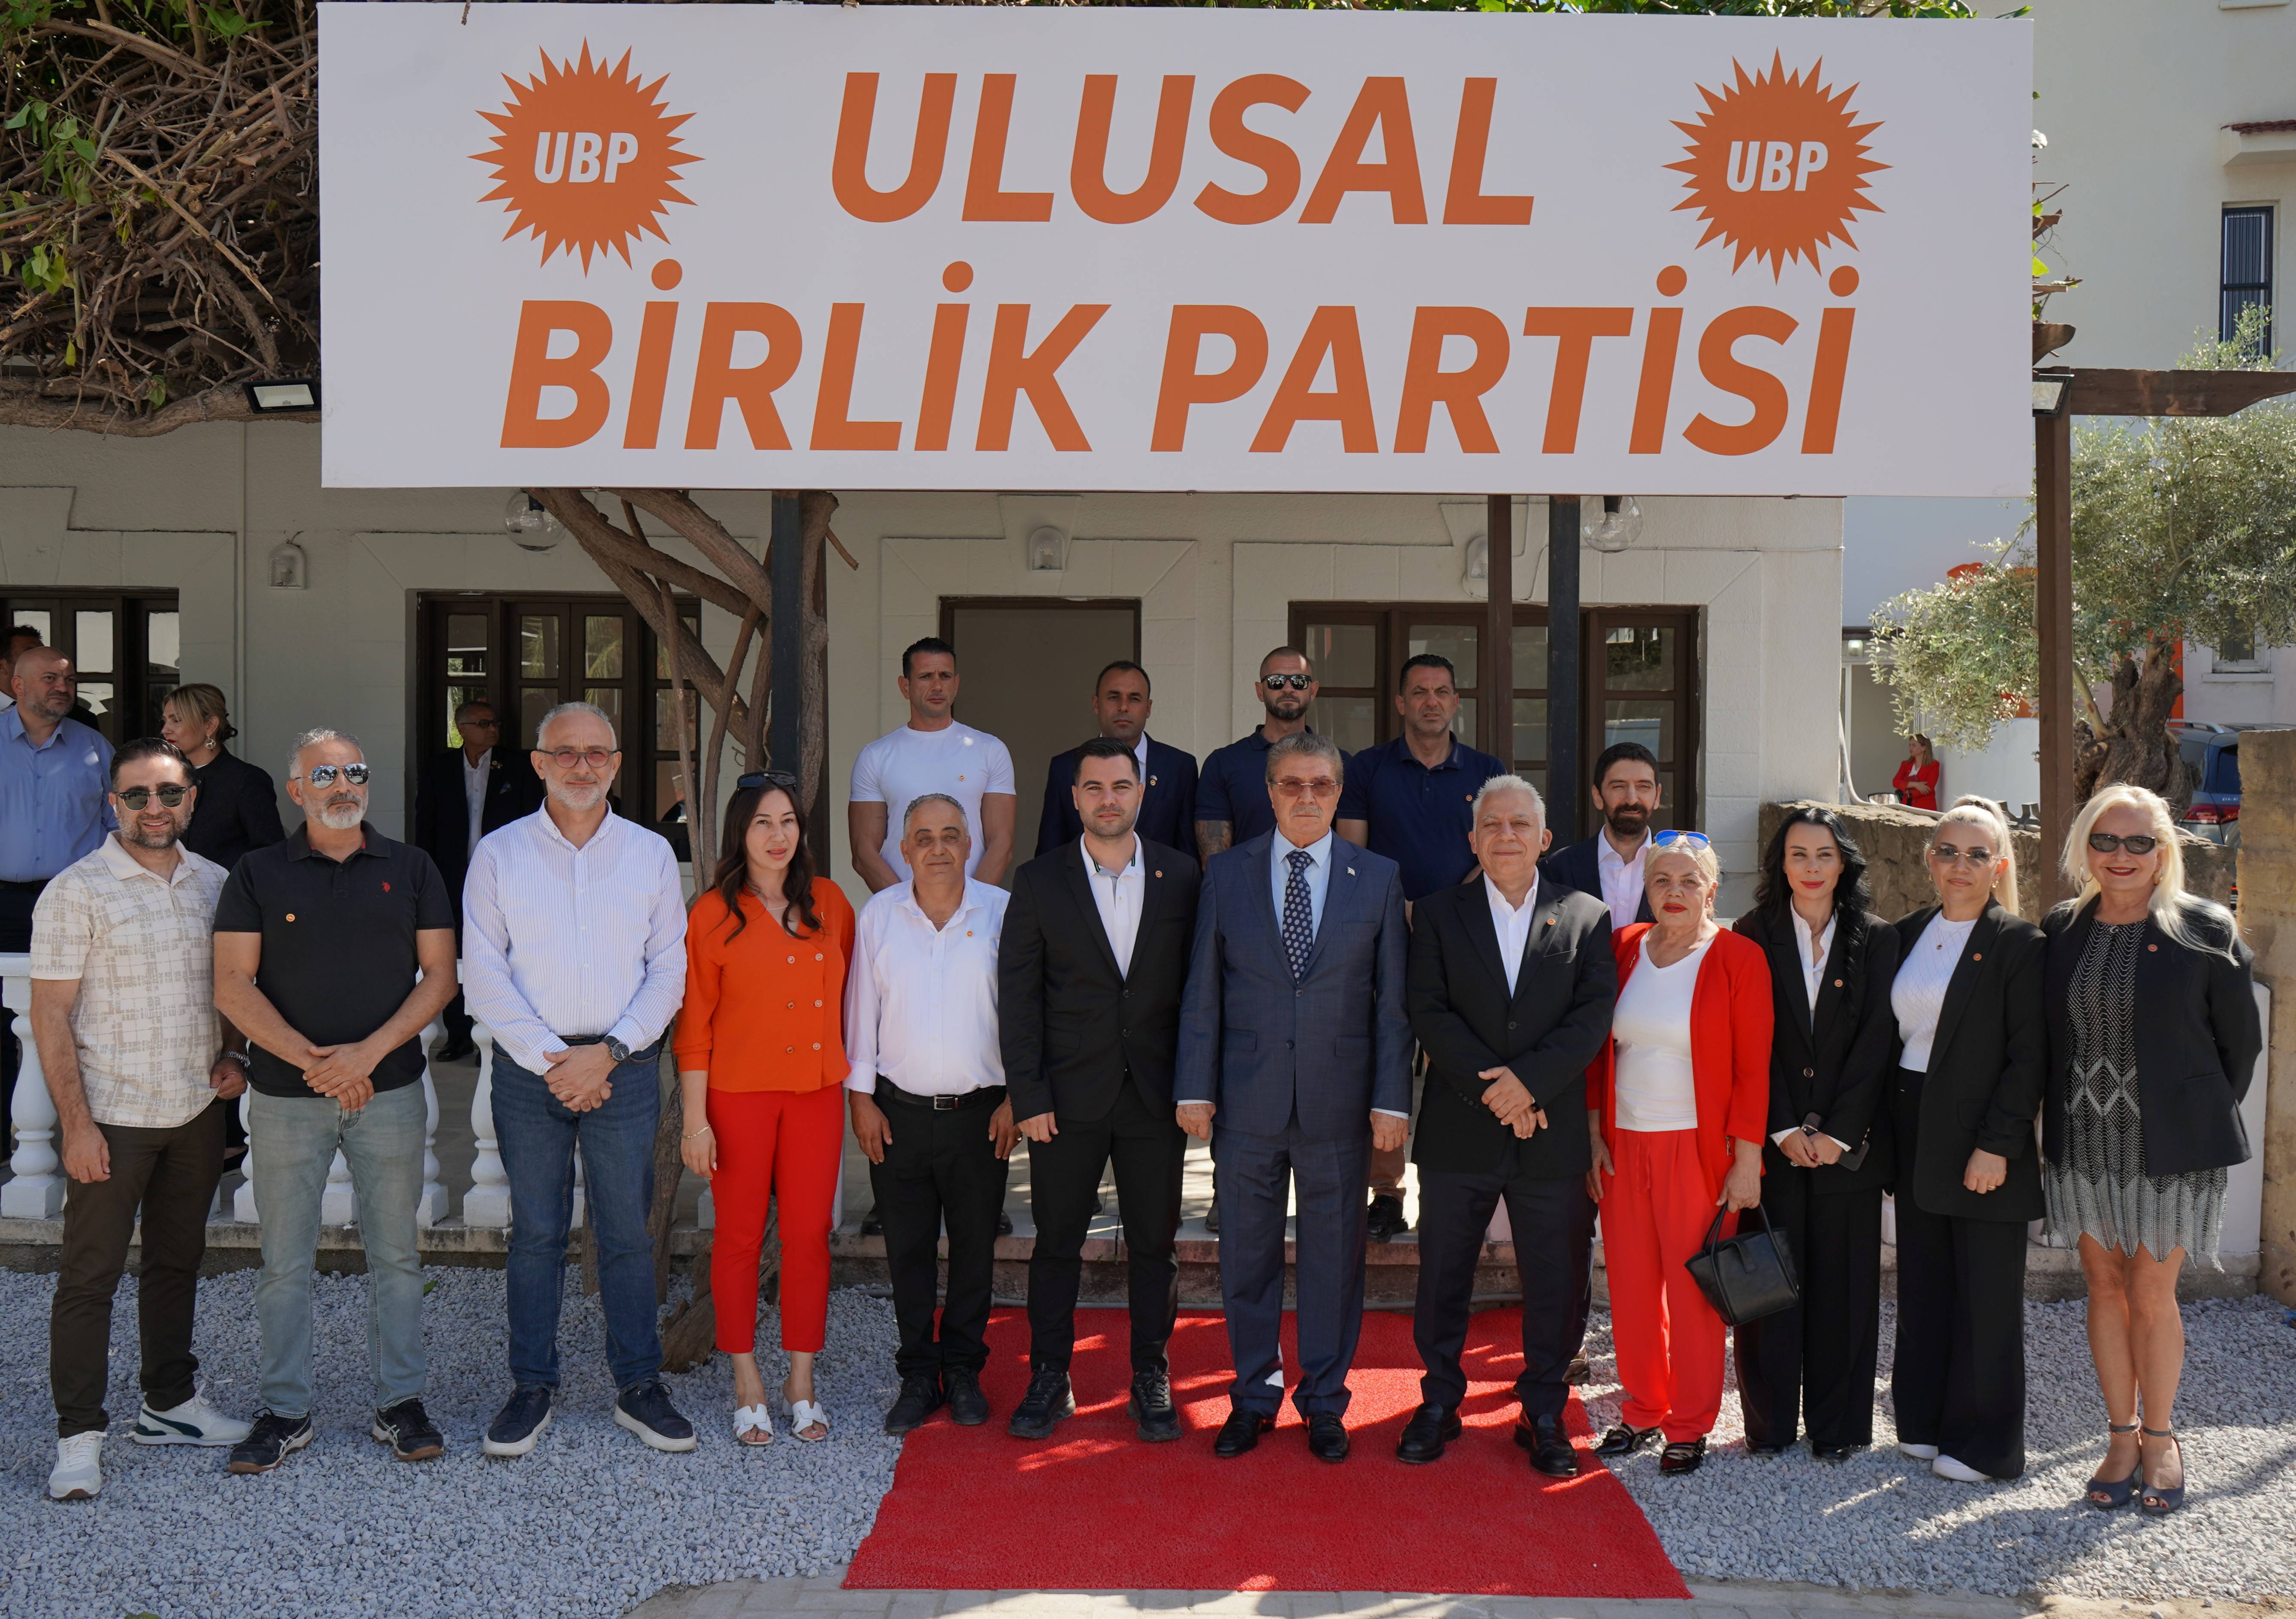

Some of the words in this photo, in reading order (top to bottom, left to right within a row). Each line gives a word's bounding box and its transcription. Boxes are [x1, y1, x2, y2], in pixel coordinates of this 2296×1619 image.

[534, 132, 638, 184] UBP
[832, 72, 1534, 225] ULUSAL
[1726, 141, 1828, 193] UBP
[500, 259, 1110, 451] BİRLİK
[1150, 265, 1859, 456] PARTİSİ
